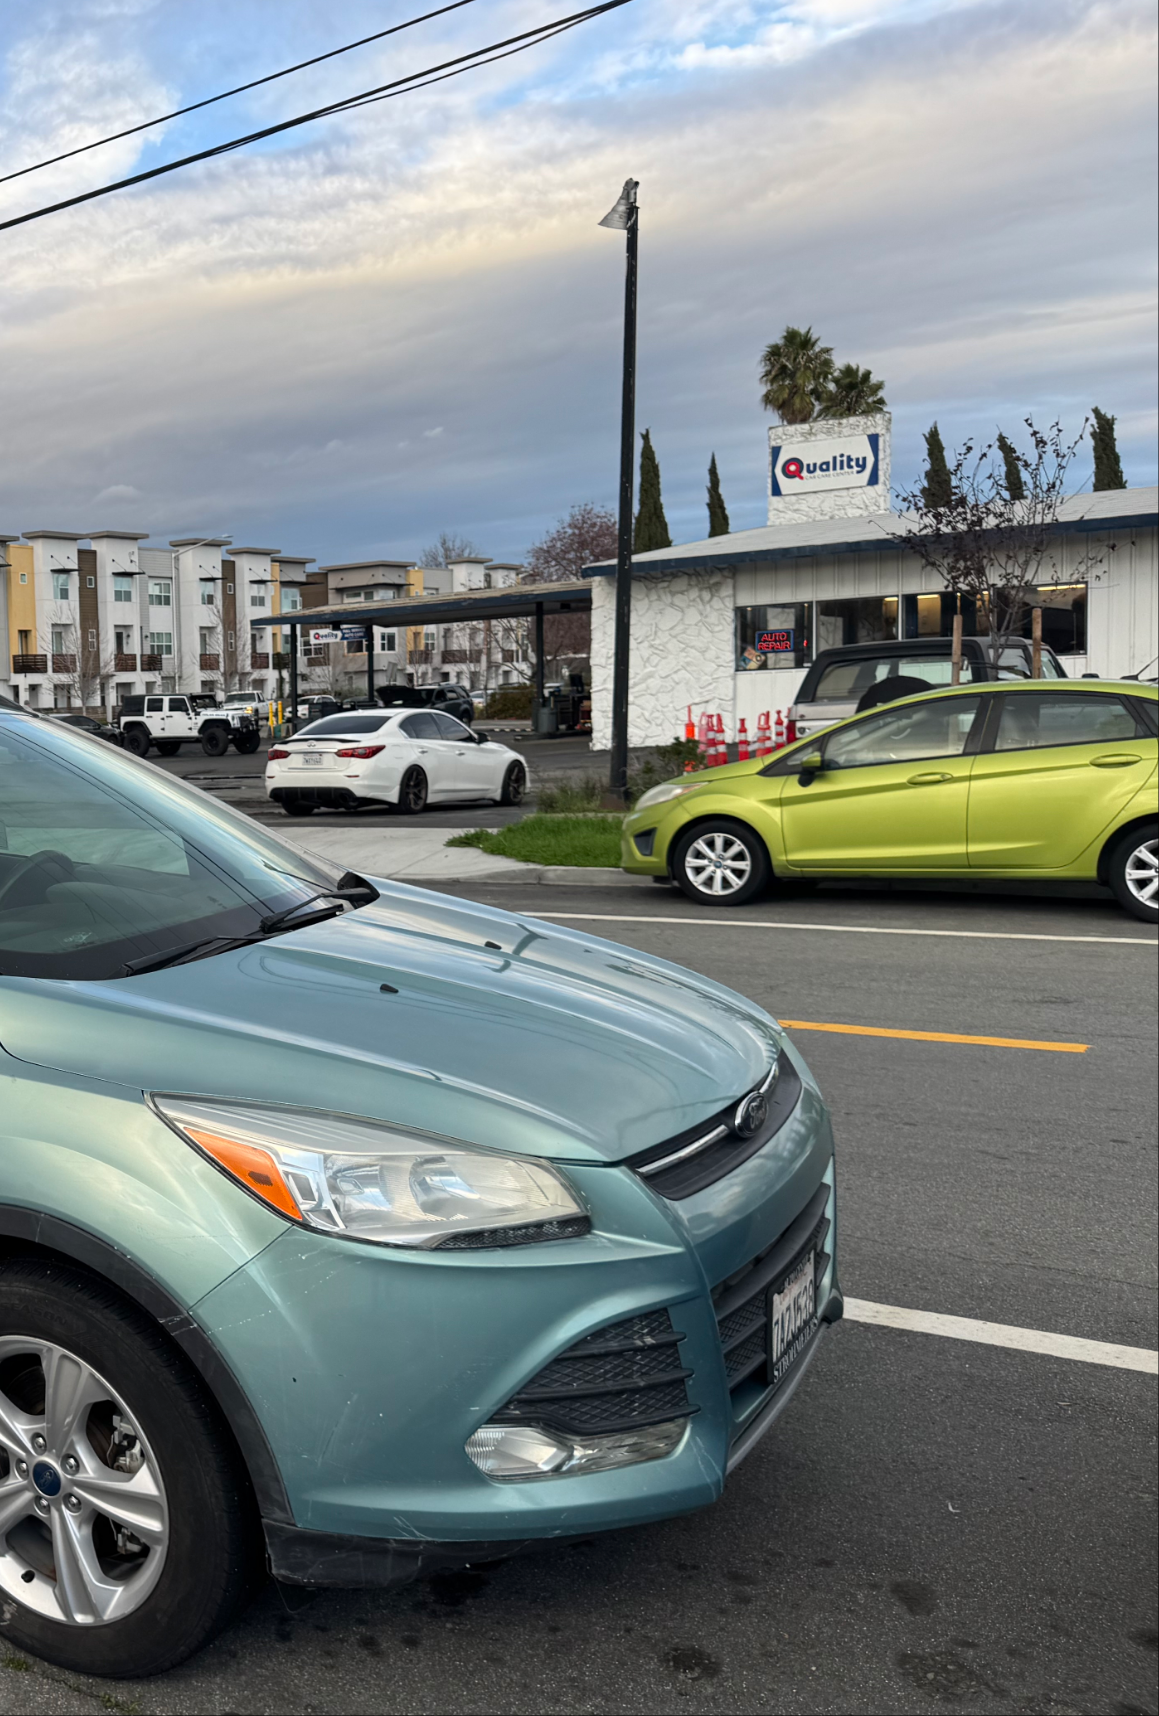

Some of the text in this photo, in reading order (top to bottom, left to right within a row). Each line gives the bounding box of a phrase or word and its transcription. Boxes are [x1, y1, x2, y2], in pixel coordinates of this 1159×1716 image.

[781, 453, 867, 480] Quality
[314, 631, 338, 640] Quality
[761, 632, 787, 641] AUTO
[758, 641, 791, 650] REPAIR
